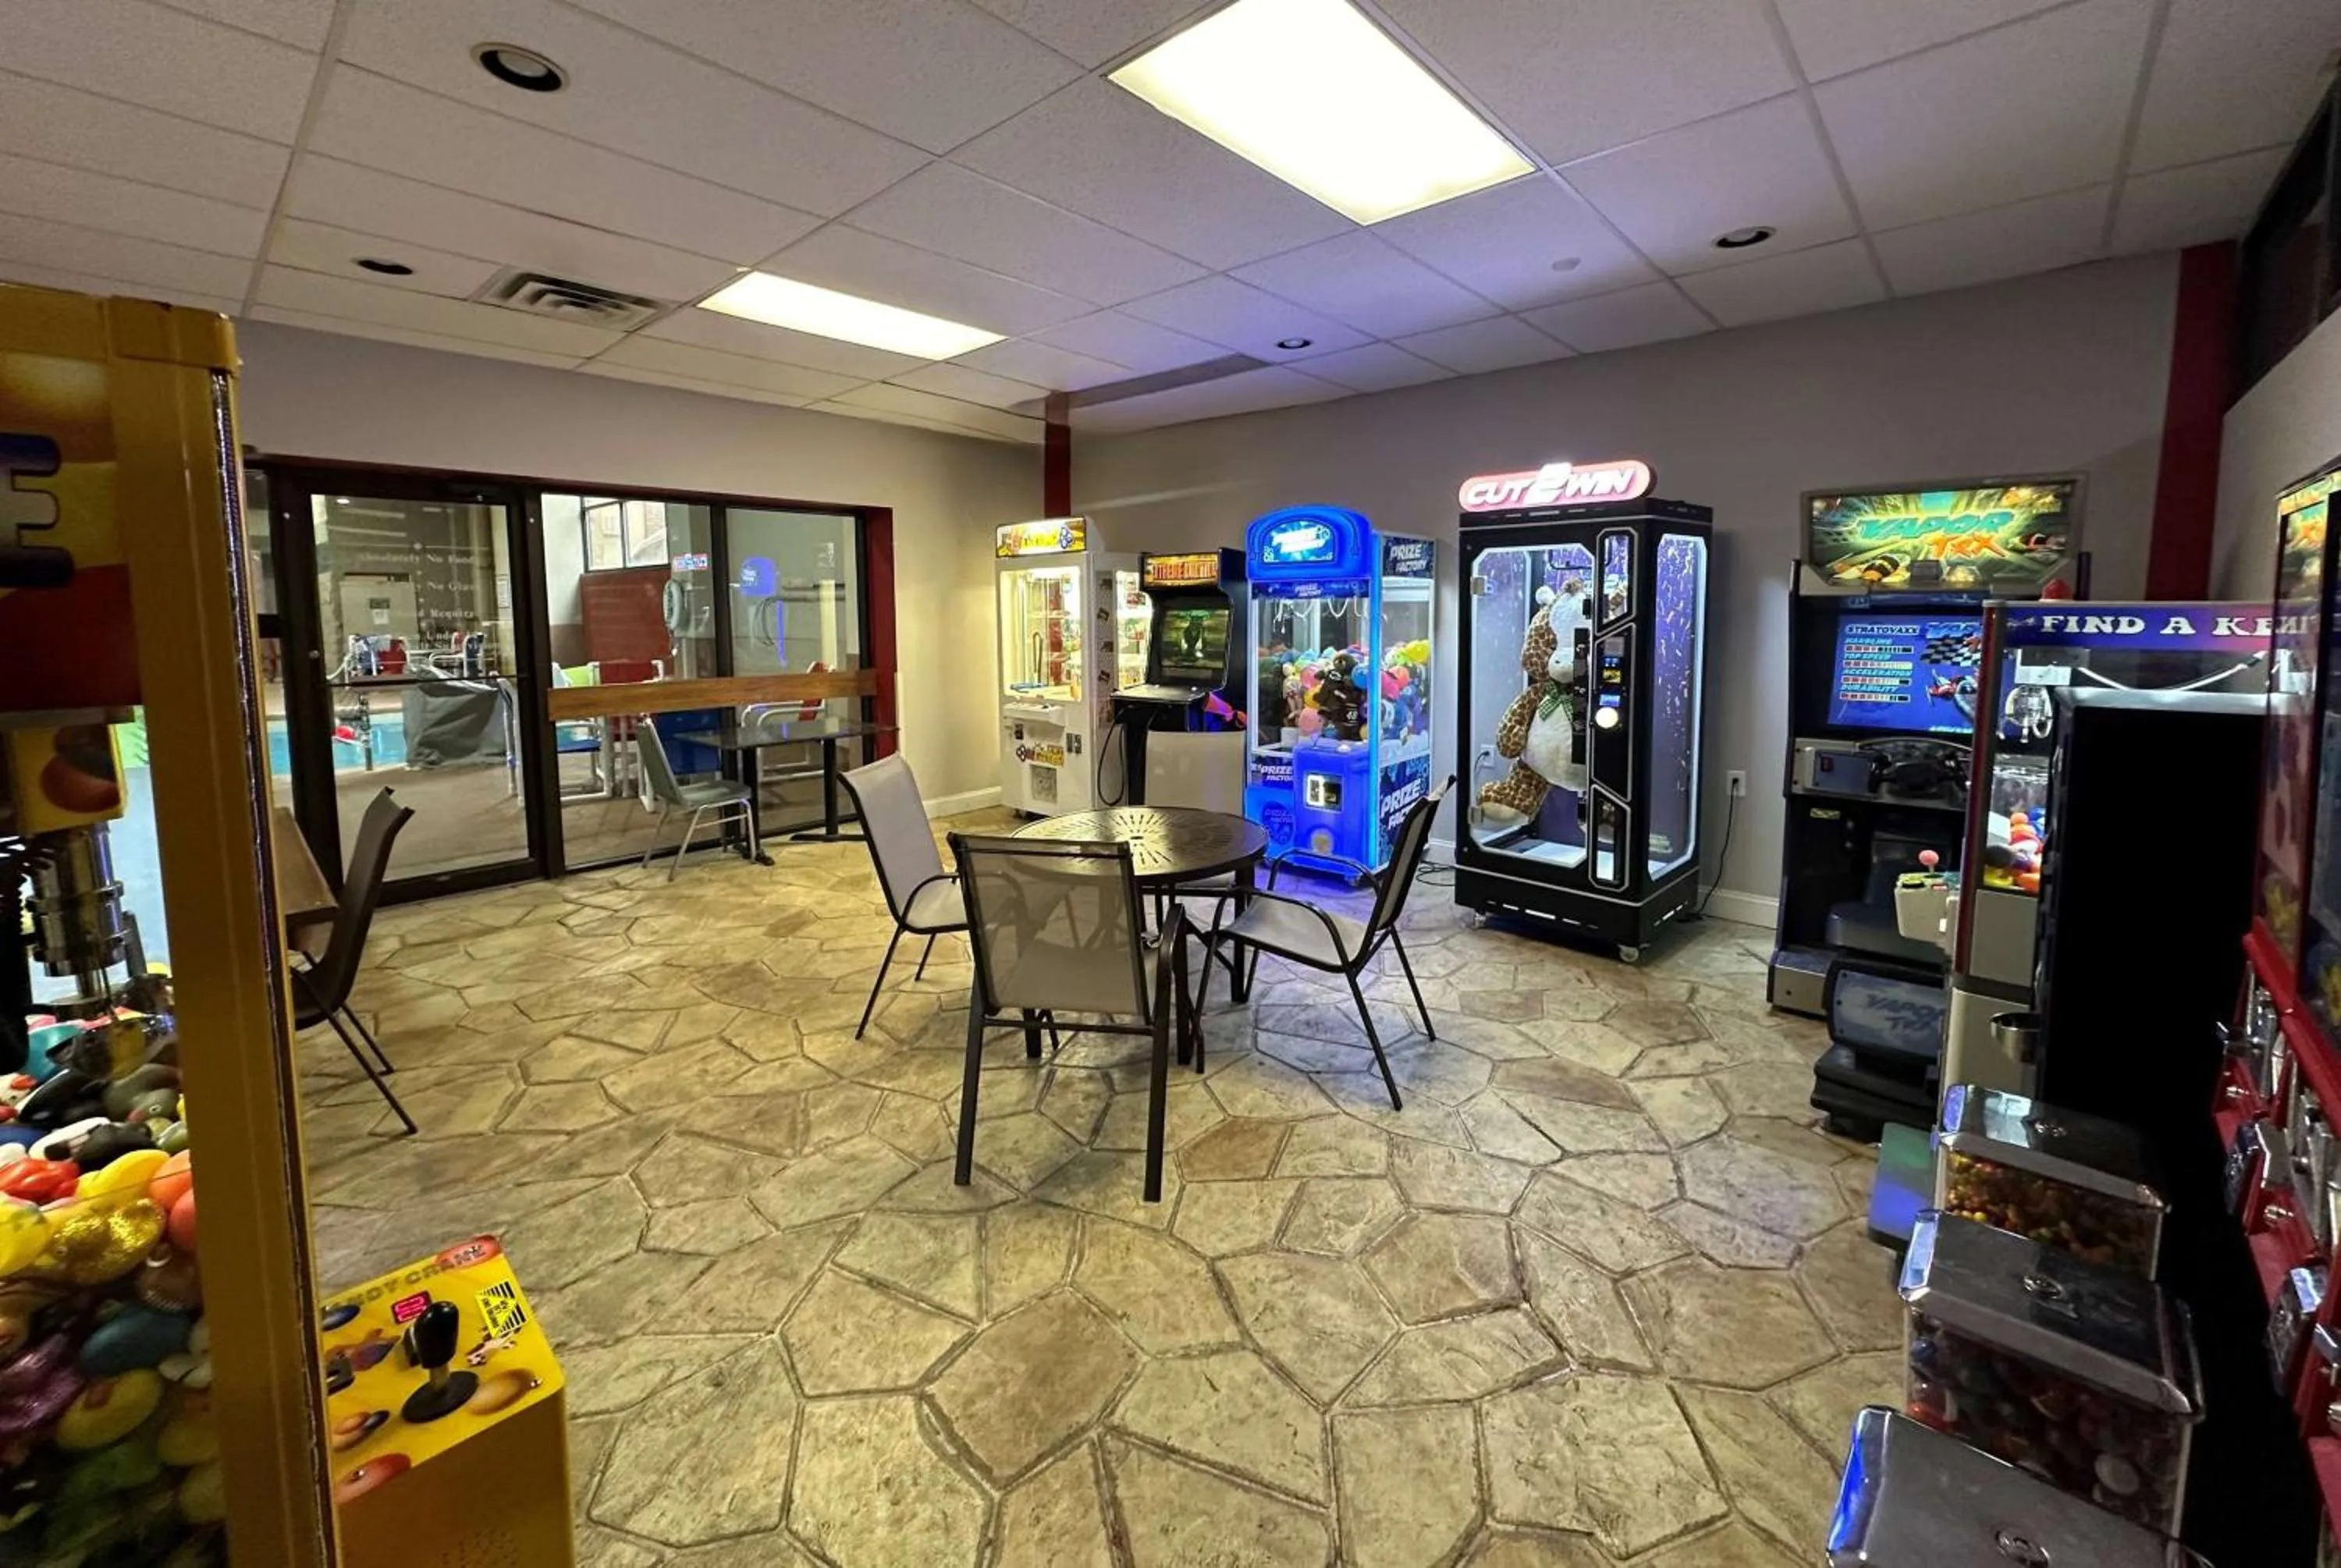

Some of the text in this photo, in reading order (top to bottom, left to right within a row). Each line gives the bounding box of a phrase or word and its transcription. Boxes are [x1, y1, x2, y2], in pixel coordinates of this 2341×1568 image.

[1858, 511, 2016, 539] VAPOR
[1390, 545, 1423, 559] PRIZE
[1929, 533, 2007, 558] TRX
[428, 552, 443, 563] No
[1396, 559, 1427, 572] FACTORY
[2041, 615, 2273, 637] FIND A KE
[1260, 765, 1293, 775] PRIZE
[1380, 779, 1421, 818] PRIZE
